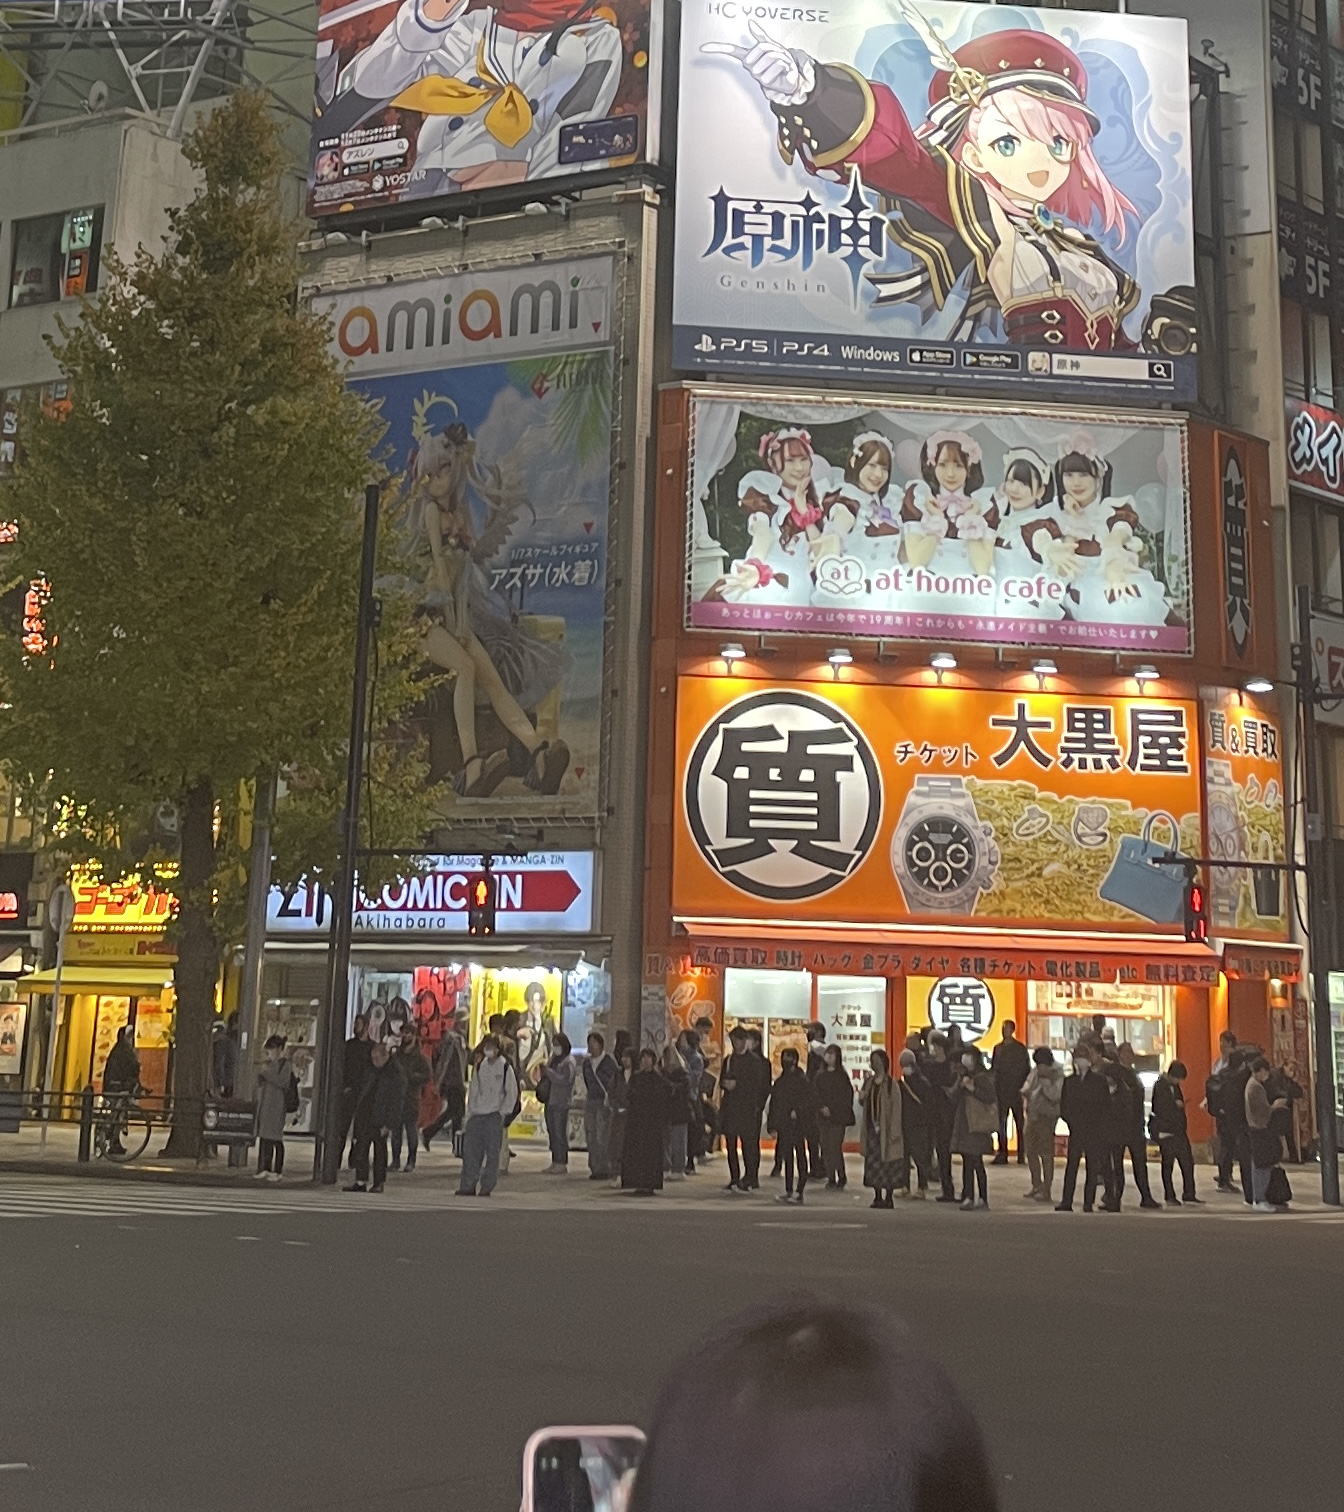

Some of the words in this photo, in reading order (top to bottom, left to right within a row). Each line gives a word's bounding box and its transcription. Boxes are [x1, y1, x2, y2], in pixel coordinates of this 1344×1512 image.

[701, 167, 888, 303] 原神
[720, 274, 827, 295] Genshin
[1305, 254, 1330, 298] 5F
[338, 276, 581, 357] amiami
[841, 345, 900, 362] Windows
[1003, 573, 1064, 600] cafe
[895, 741, 979, 765] チケット
[989, 699, 1191, 775] 大黒屋
[707, 722, 863, 876] 質
[353, 913, 447, 930] Akihabara
